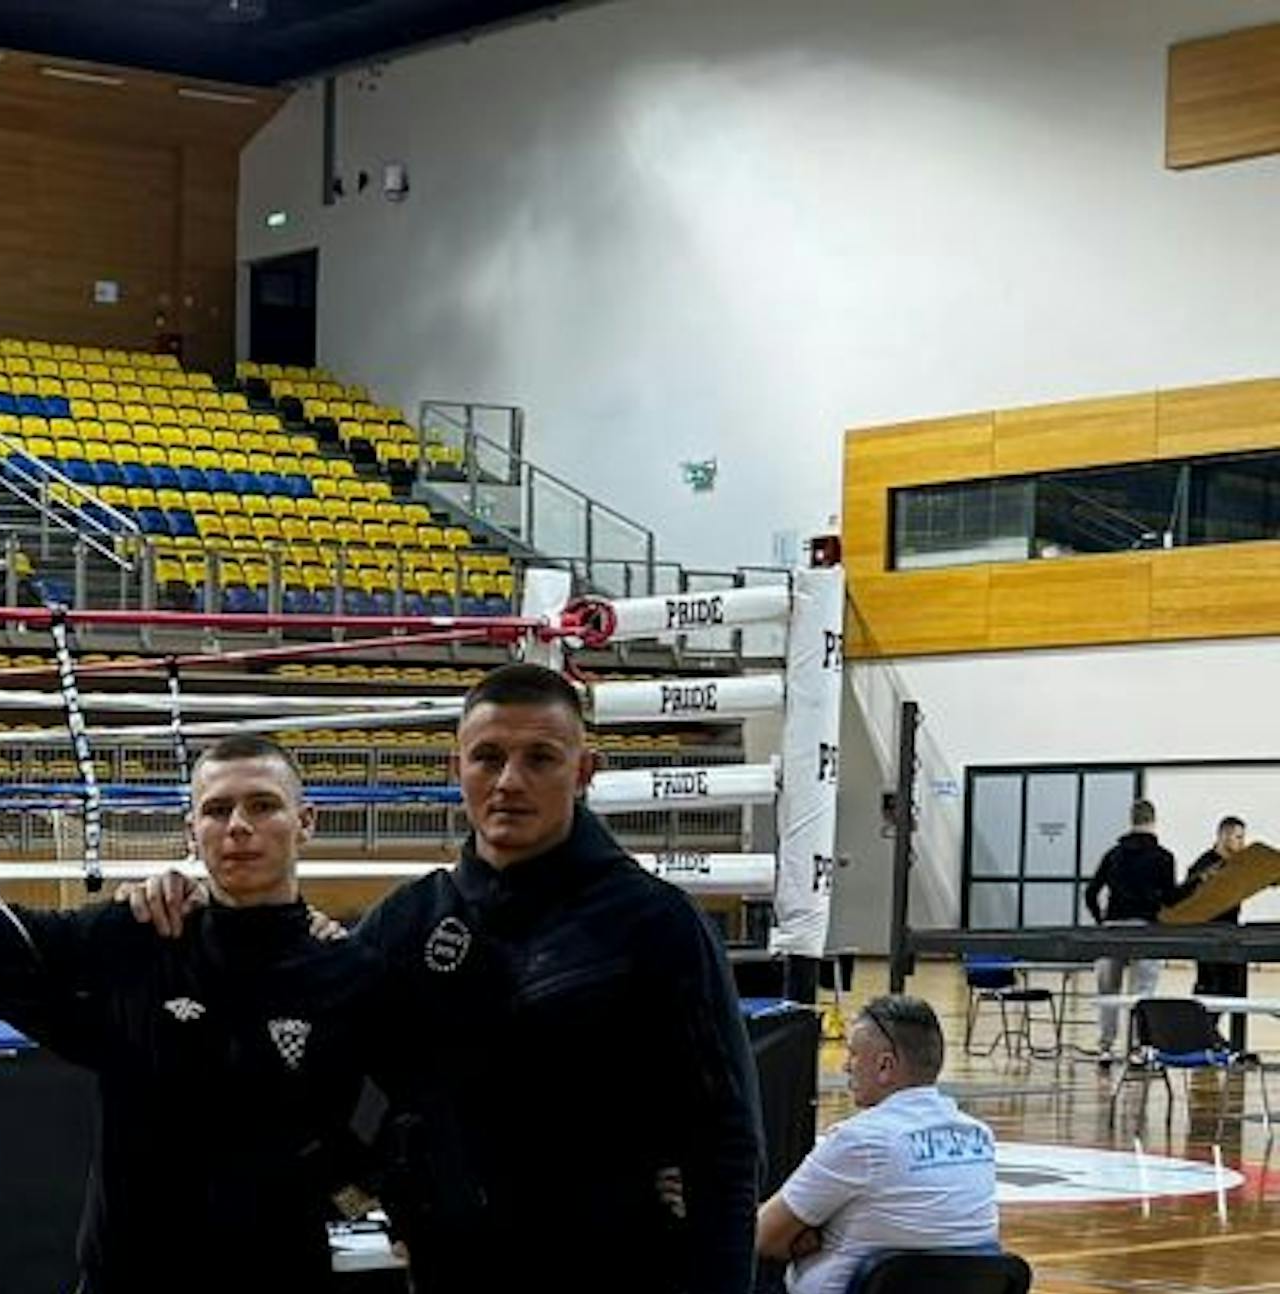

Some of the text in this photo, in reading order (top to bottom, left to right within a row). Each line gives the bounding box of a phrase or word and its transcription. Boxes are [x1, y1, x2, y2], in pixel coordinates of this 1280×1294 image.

[666, 596, 724, 628] PRIDE
[660, 683, 718, 714] PRIDE
[652, 771, 708, 798] PRIDE
